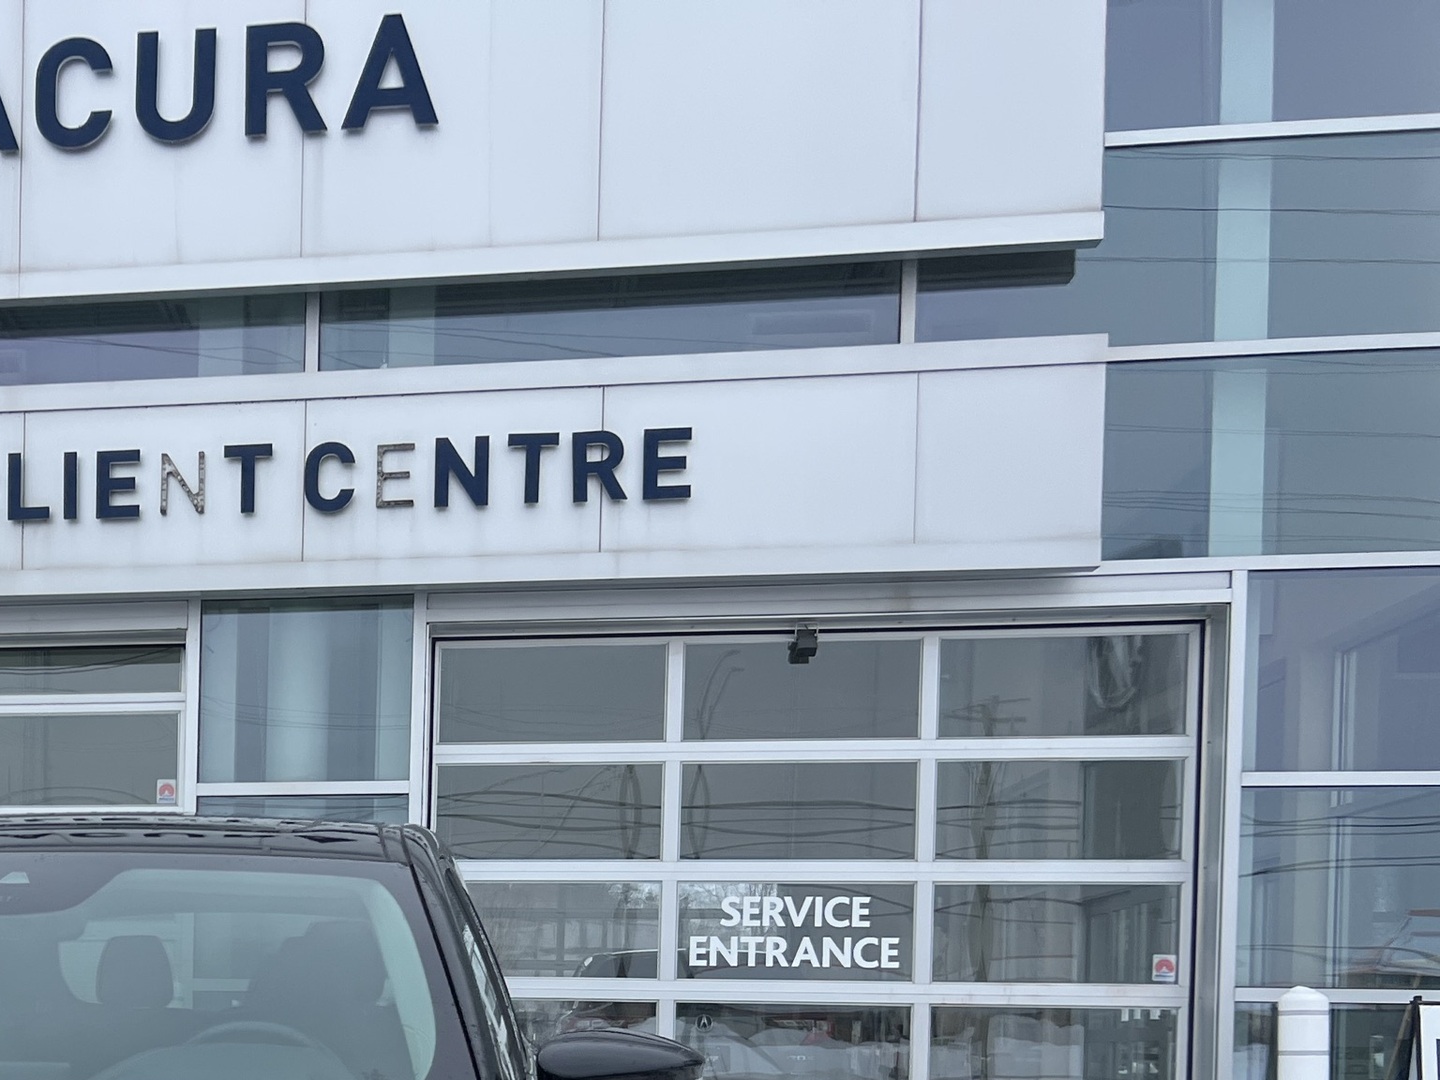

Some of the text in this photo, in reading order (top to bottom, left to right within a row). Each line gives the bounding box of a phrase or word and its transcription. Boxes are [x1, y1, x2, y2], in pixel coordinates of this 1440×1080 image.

[303, 427, 693, 516] CENTRE
[720, 896, 871, 928] SERVICE
[688, 936, 900, 969] ENTRANCE
